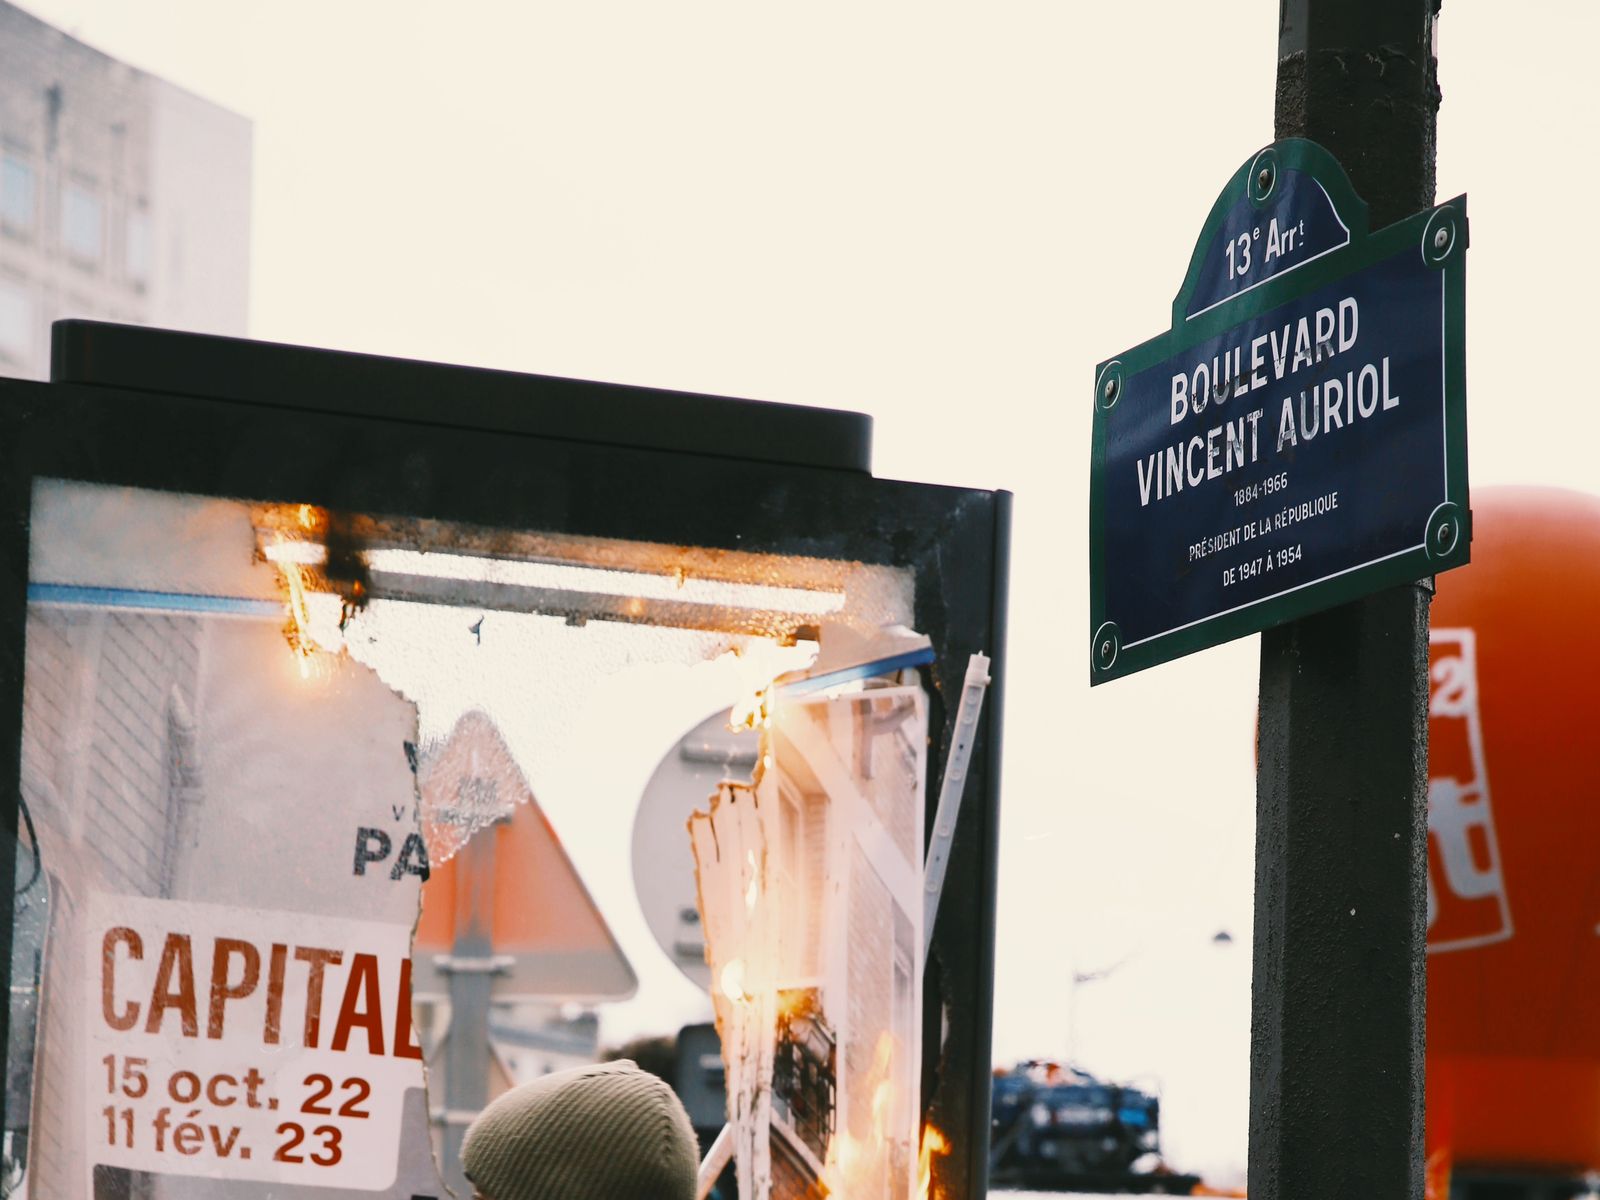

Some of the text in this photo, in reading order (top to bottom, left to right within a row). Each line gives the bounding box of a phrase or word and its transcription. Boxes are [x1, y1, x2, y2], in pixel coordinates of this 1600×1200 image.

[1170, 296, 1359, 426] BOULEVARD
[1136, 356, 1400, 507] VINCENT AURIOL
[1233, 471, 1288, 507] 1884-1966
[1189, 491, 1339, 572] PRÉSIDENT DE LA RÉPUBLIQUE
[1223, 543, 1302, 587] DE 1947 À 1954
[102, 1053, 371, 1119] 15 oct. 22
[102, 1105, 343, 1167] 11 fév. 23
